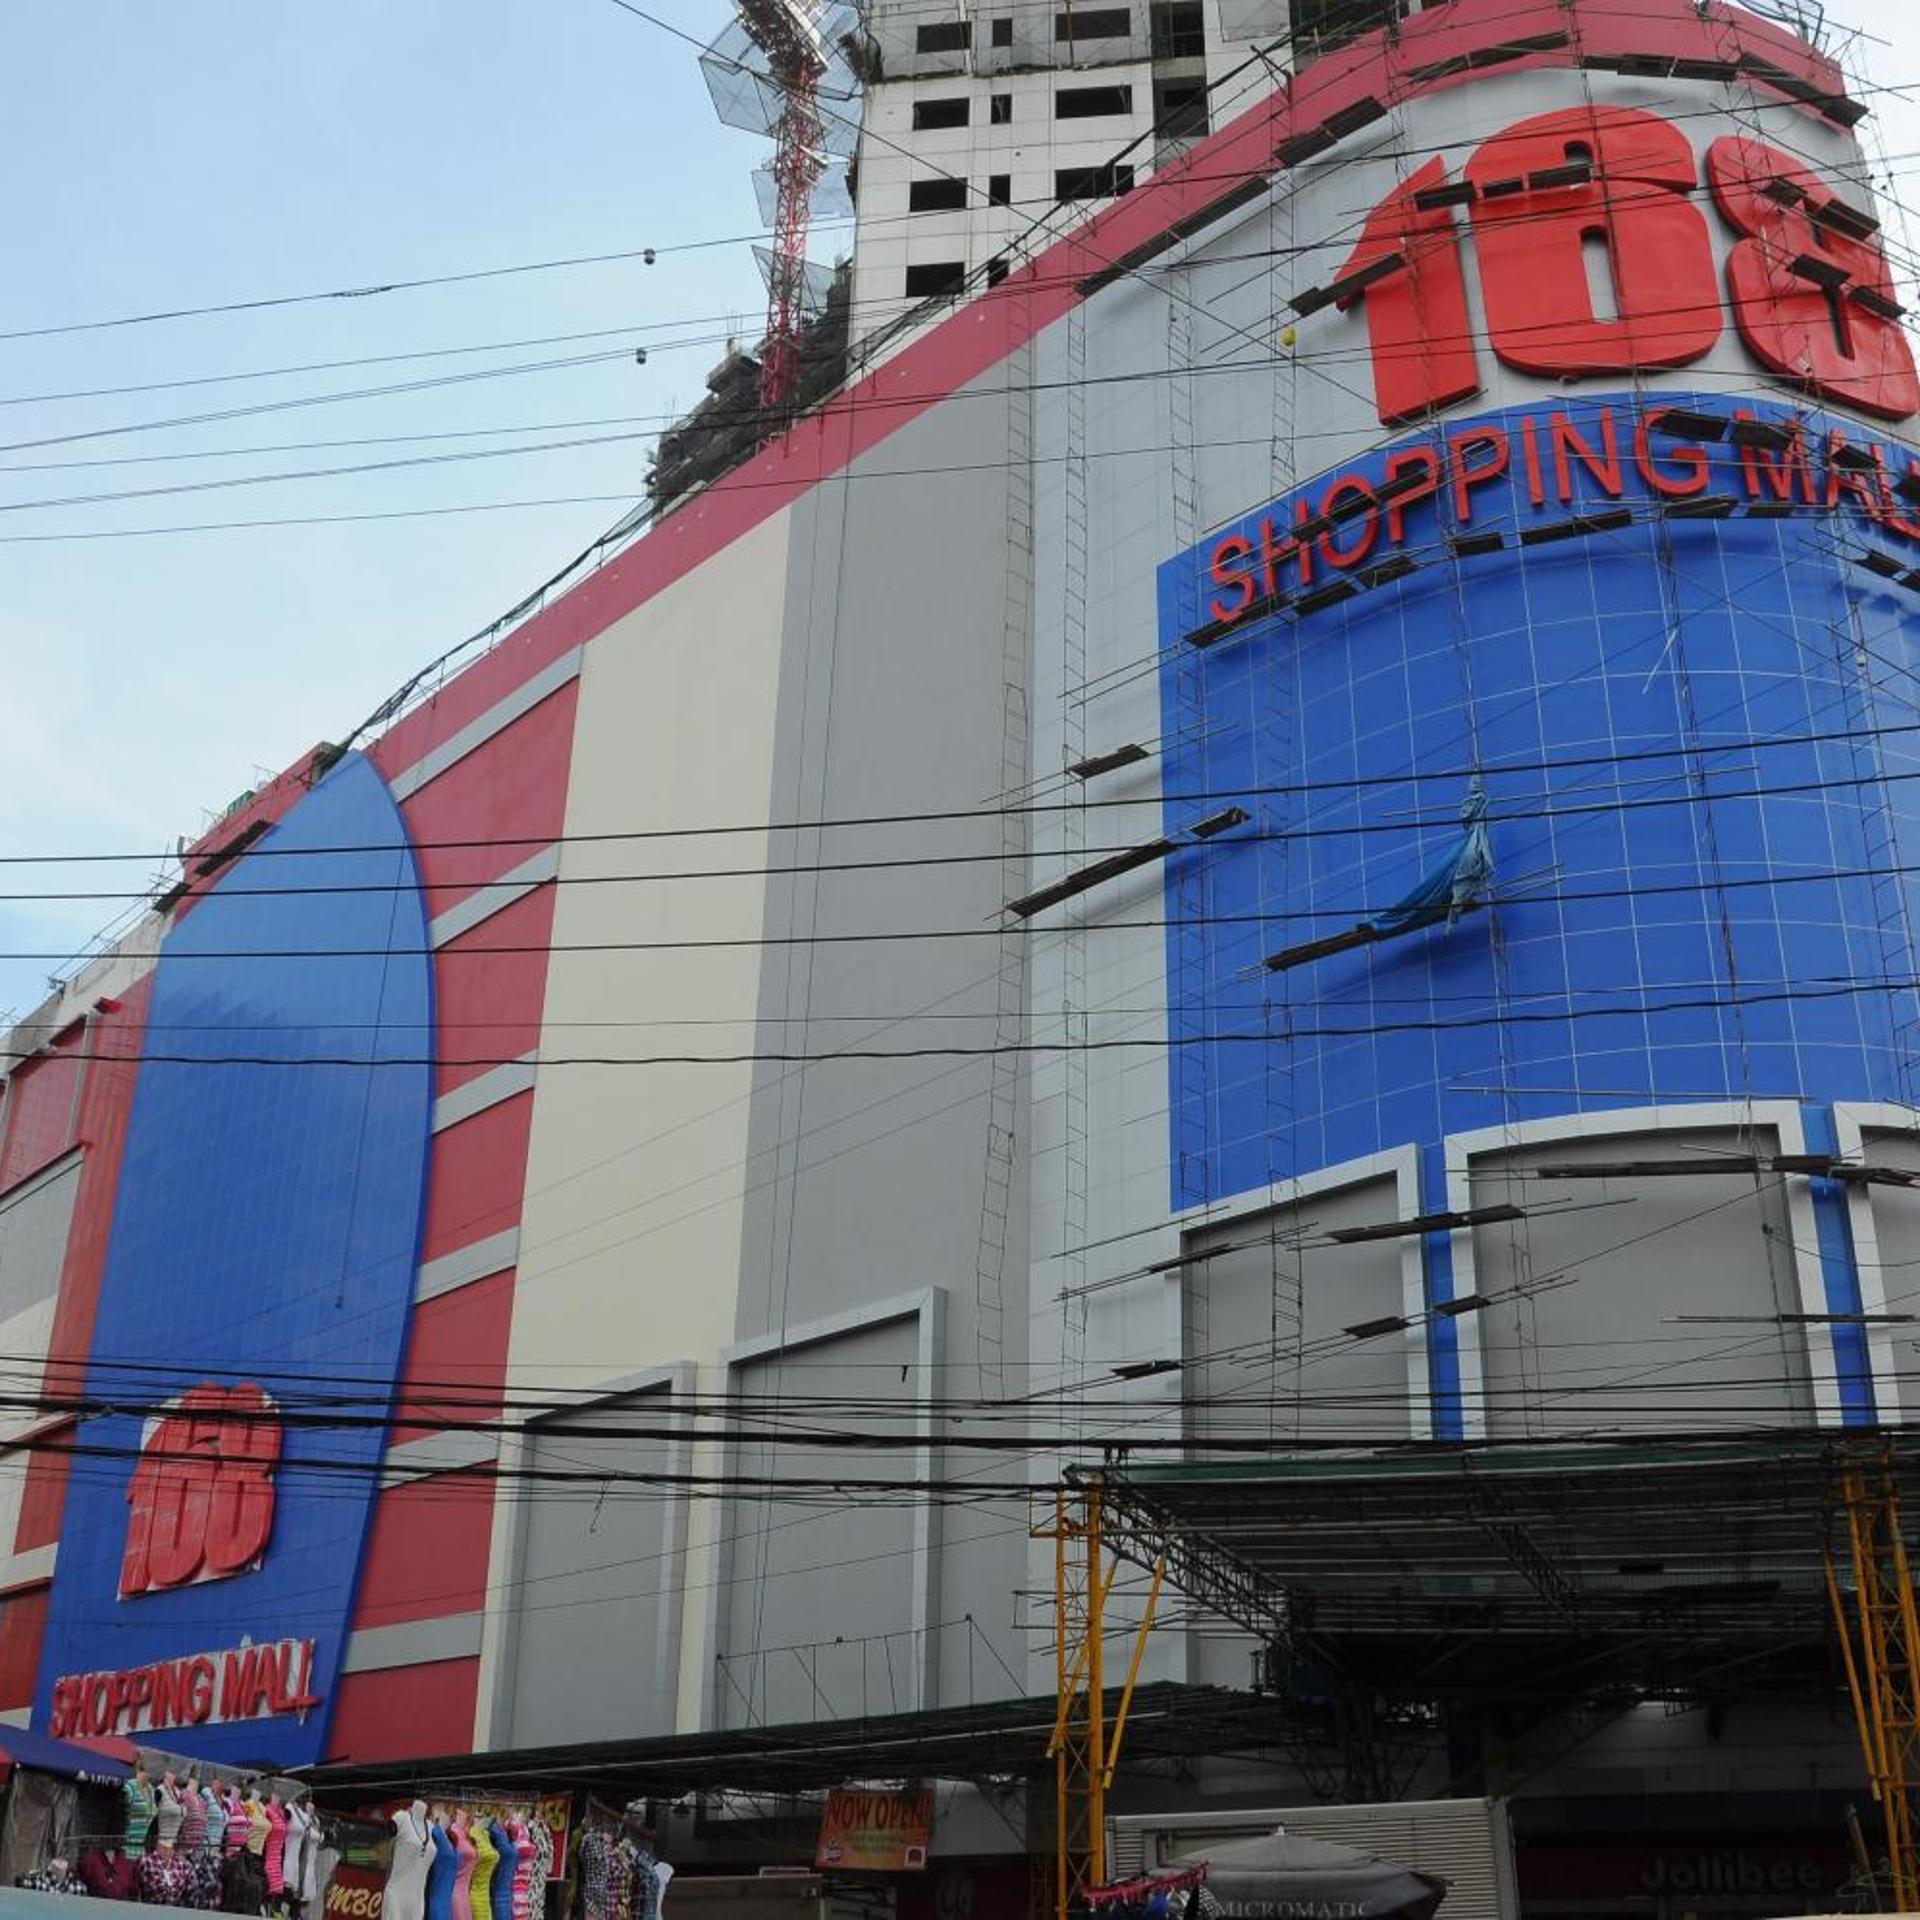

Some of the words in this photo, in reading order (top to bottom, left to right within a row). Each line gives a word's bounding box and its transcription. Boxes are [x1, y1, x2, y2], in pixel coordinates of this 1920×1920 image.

[1333, 104, 1919, 425] 168
[1210, 407, 1709, 622] SHOPPING
[1734, 409, 1920, 538] MAL
[52, 1657, 216, 1738] SHOPPING
[219, 1638, 321, 1720] MALL
[825, 1796, 871, 1830] NOW
[1640, 1851, 1824, 1892] Jollibee
